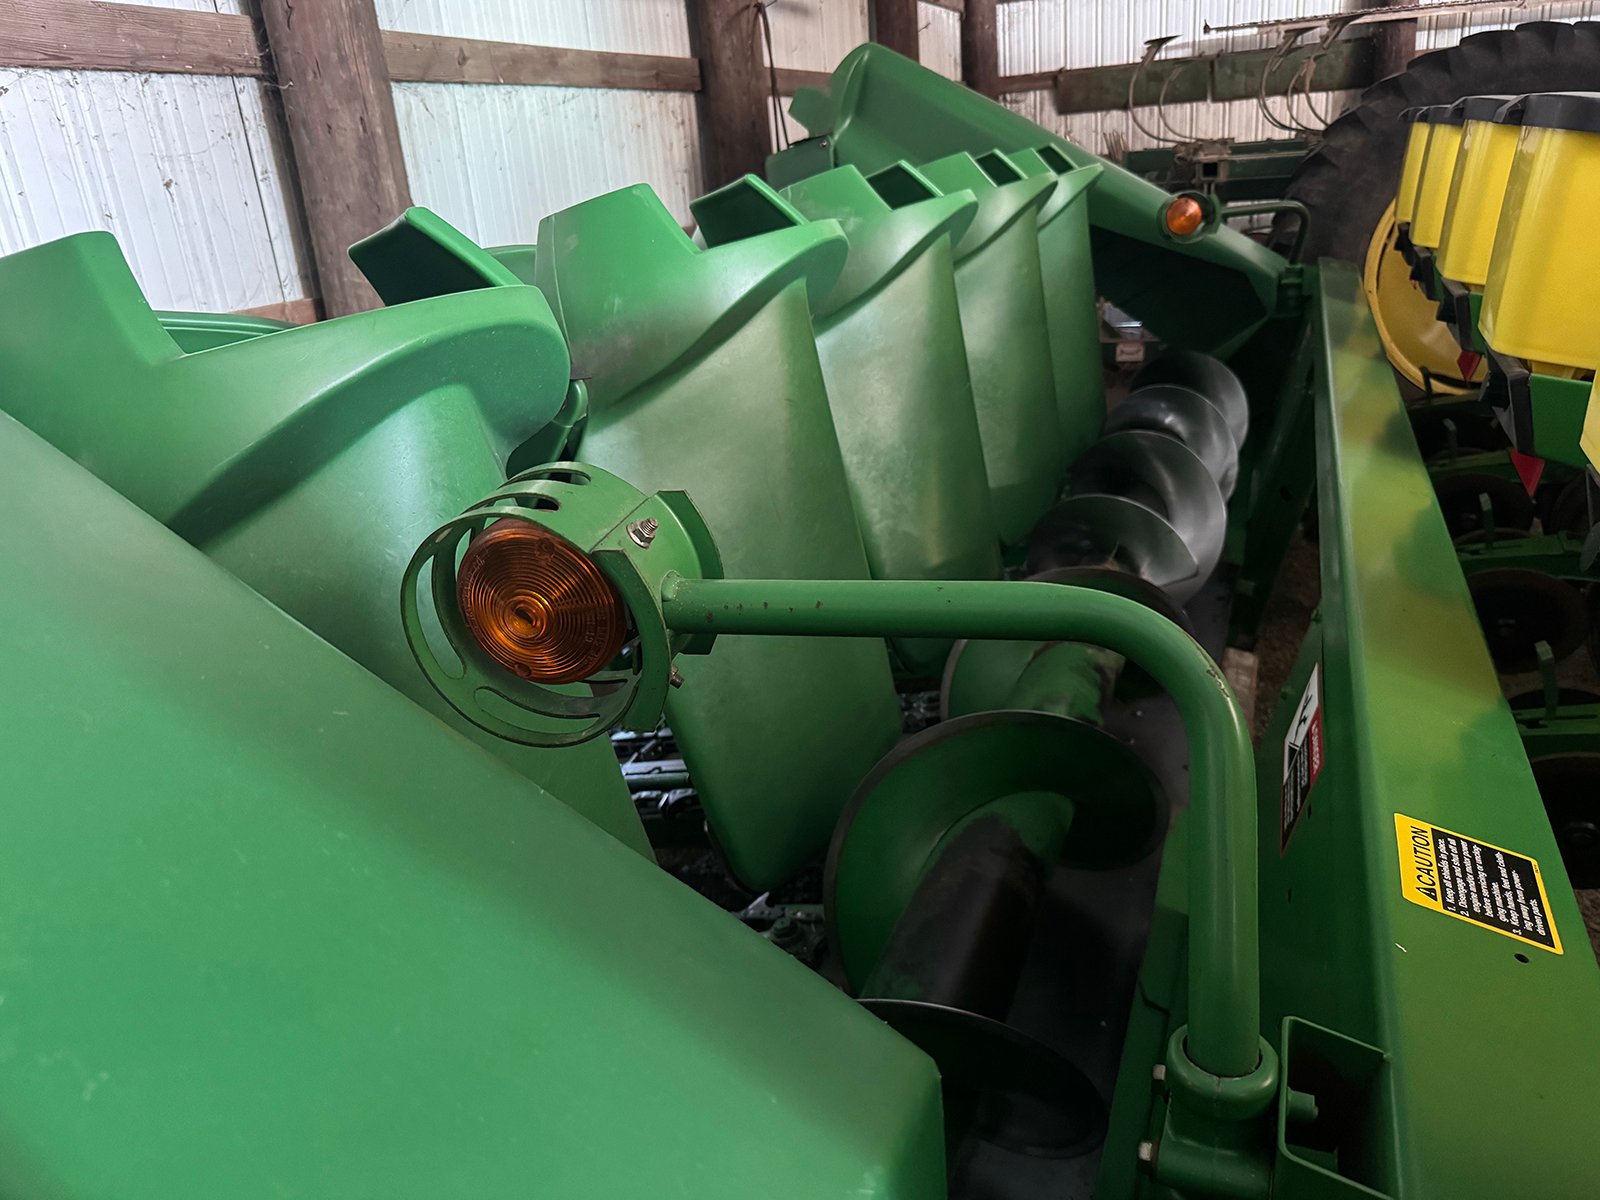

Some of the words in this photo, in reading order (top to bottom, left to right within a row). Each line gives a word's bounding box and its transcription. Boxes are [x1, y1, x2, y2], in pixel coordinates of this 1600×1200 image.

[1411, 826, 1435, 886] CAUTION
[1445, 888, 1456, 904] Keep
[1509, 910, 1520, 927] Keep
